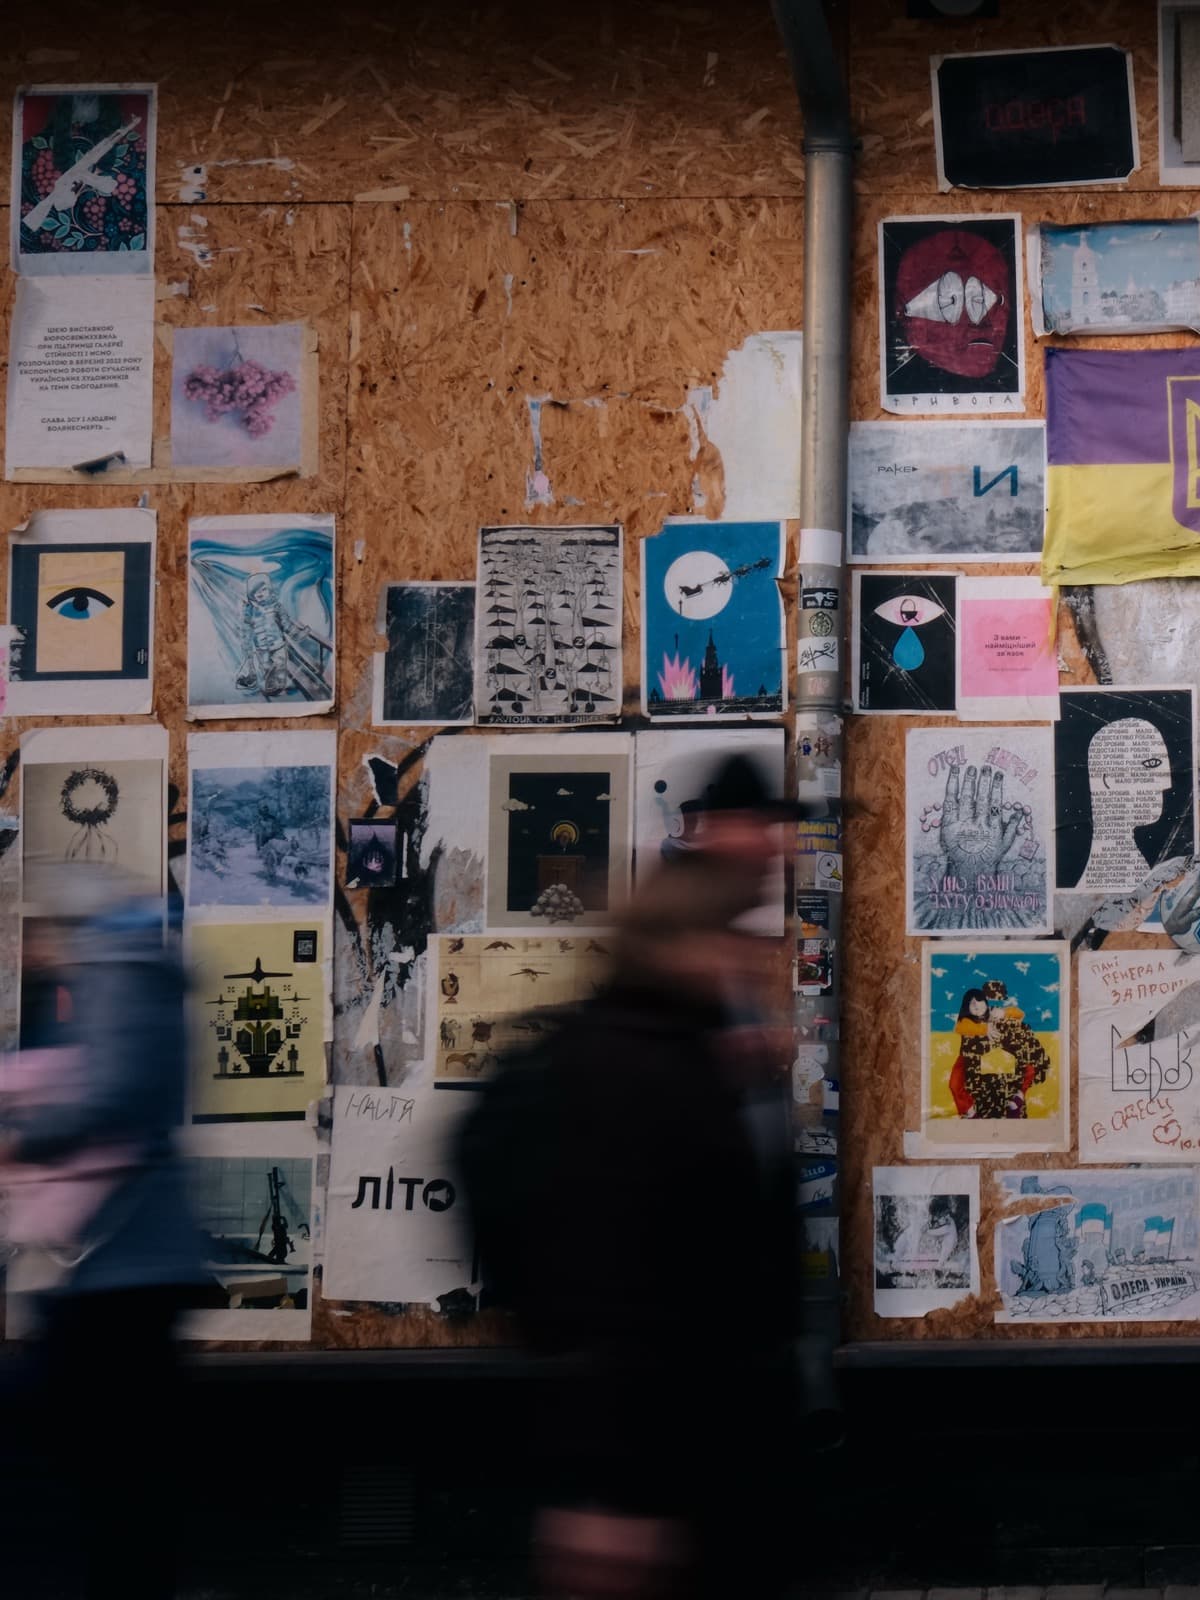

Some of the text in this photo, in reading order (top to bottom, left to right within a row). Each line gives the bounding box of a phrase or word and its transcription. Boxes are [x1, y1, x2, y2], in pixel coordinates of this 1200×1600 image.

[351, 1164, 456, 1213] ЛІТО
[1110, 1278, 1150, 1300] ОДЕСА
[1154, 1276, 1188, 1289] УКРАЇНА
